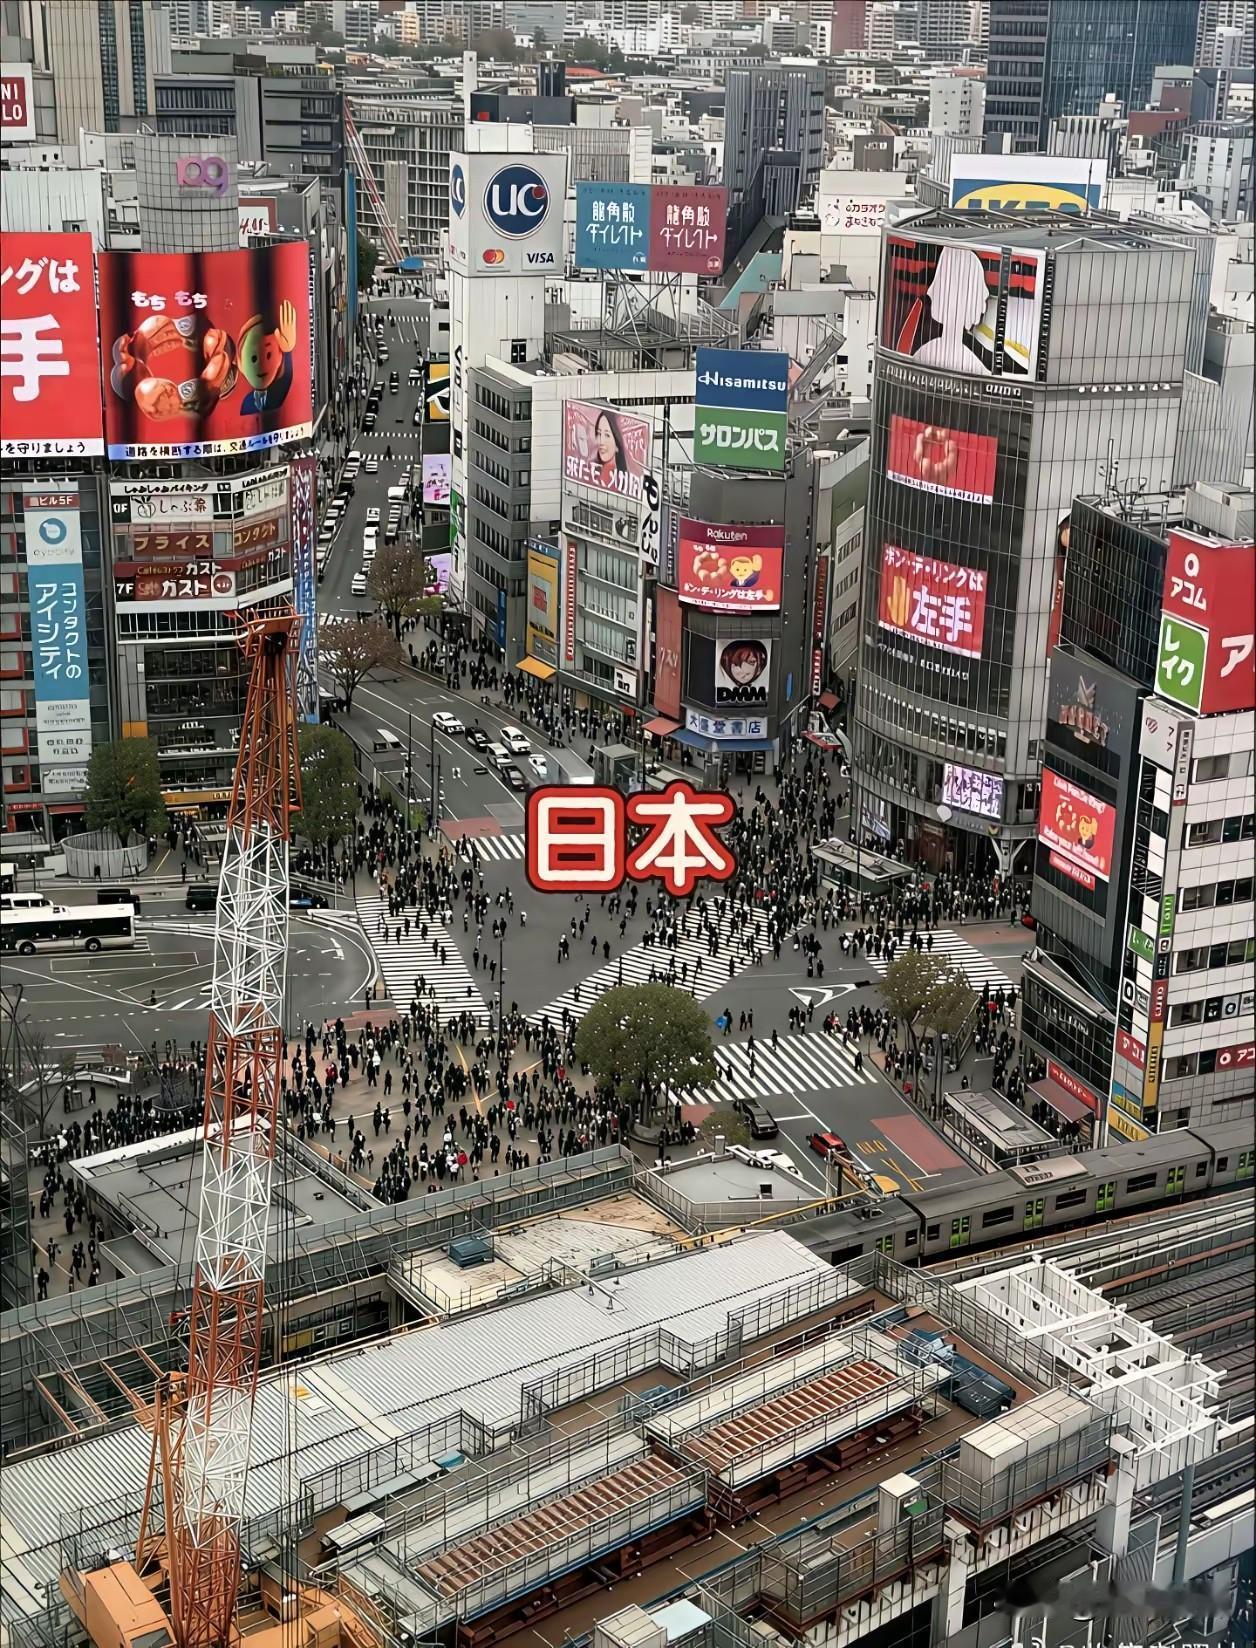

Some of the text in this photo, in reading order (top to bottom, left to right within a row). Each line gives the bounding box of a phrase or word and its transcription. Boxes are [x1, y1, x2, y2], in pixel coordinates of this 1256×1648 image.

[176, 157, 228, 197] 109
[526, 253, 554, 263] VISA
[1, 313, 71, 402] 手
[698, 371, 786, 391] Hisamitsu
[1, 442, 86, 454] を守りましょう
[700, 423, 779, 452] サロンパス
[707, 528, 748, 541] Rakuten
[117, 583, 134, 595] 7F
[1170, 576, 1207, 611] アコム
[911, 584, 973, 643] 左手
[35, 583, 60, 680] アイシティ
[62, 583, 81, 679] コンタクトの
[716, 686, 767, 703] DMM
[689, 714, 762, 734] 大堂店
